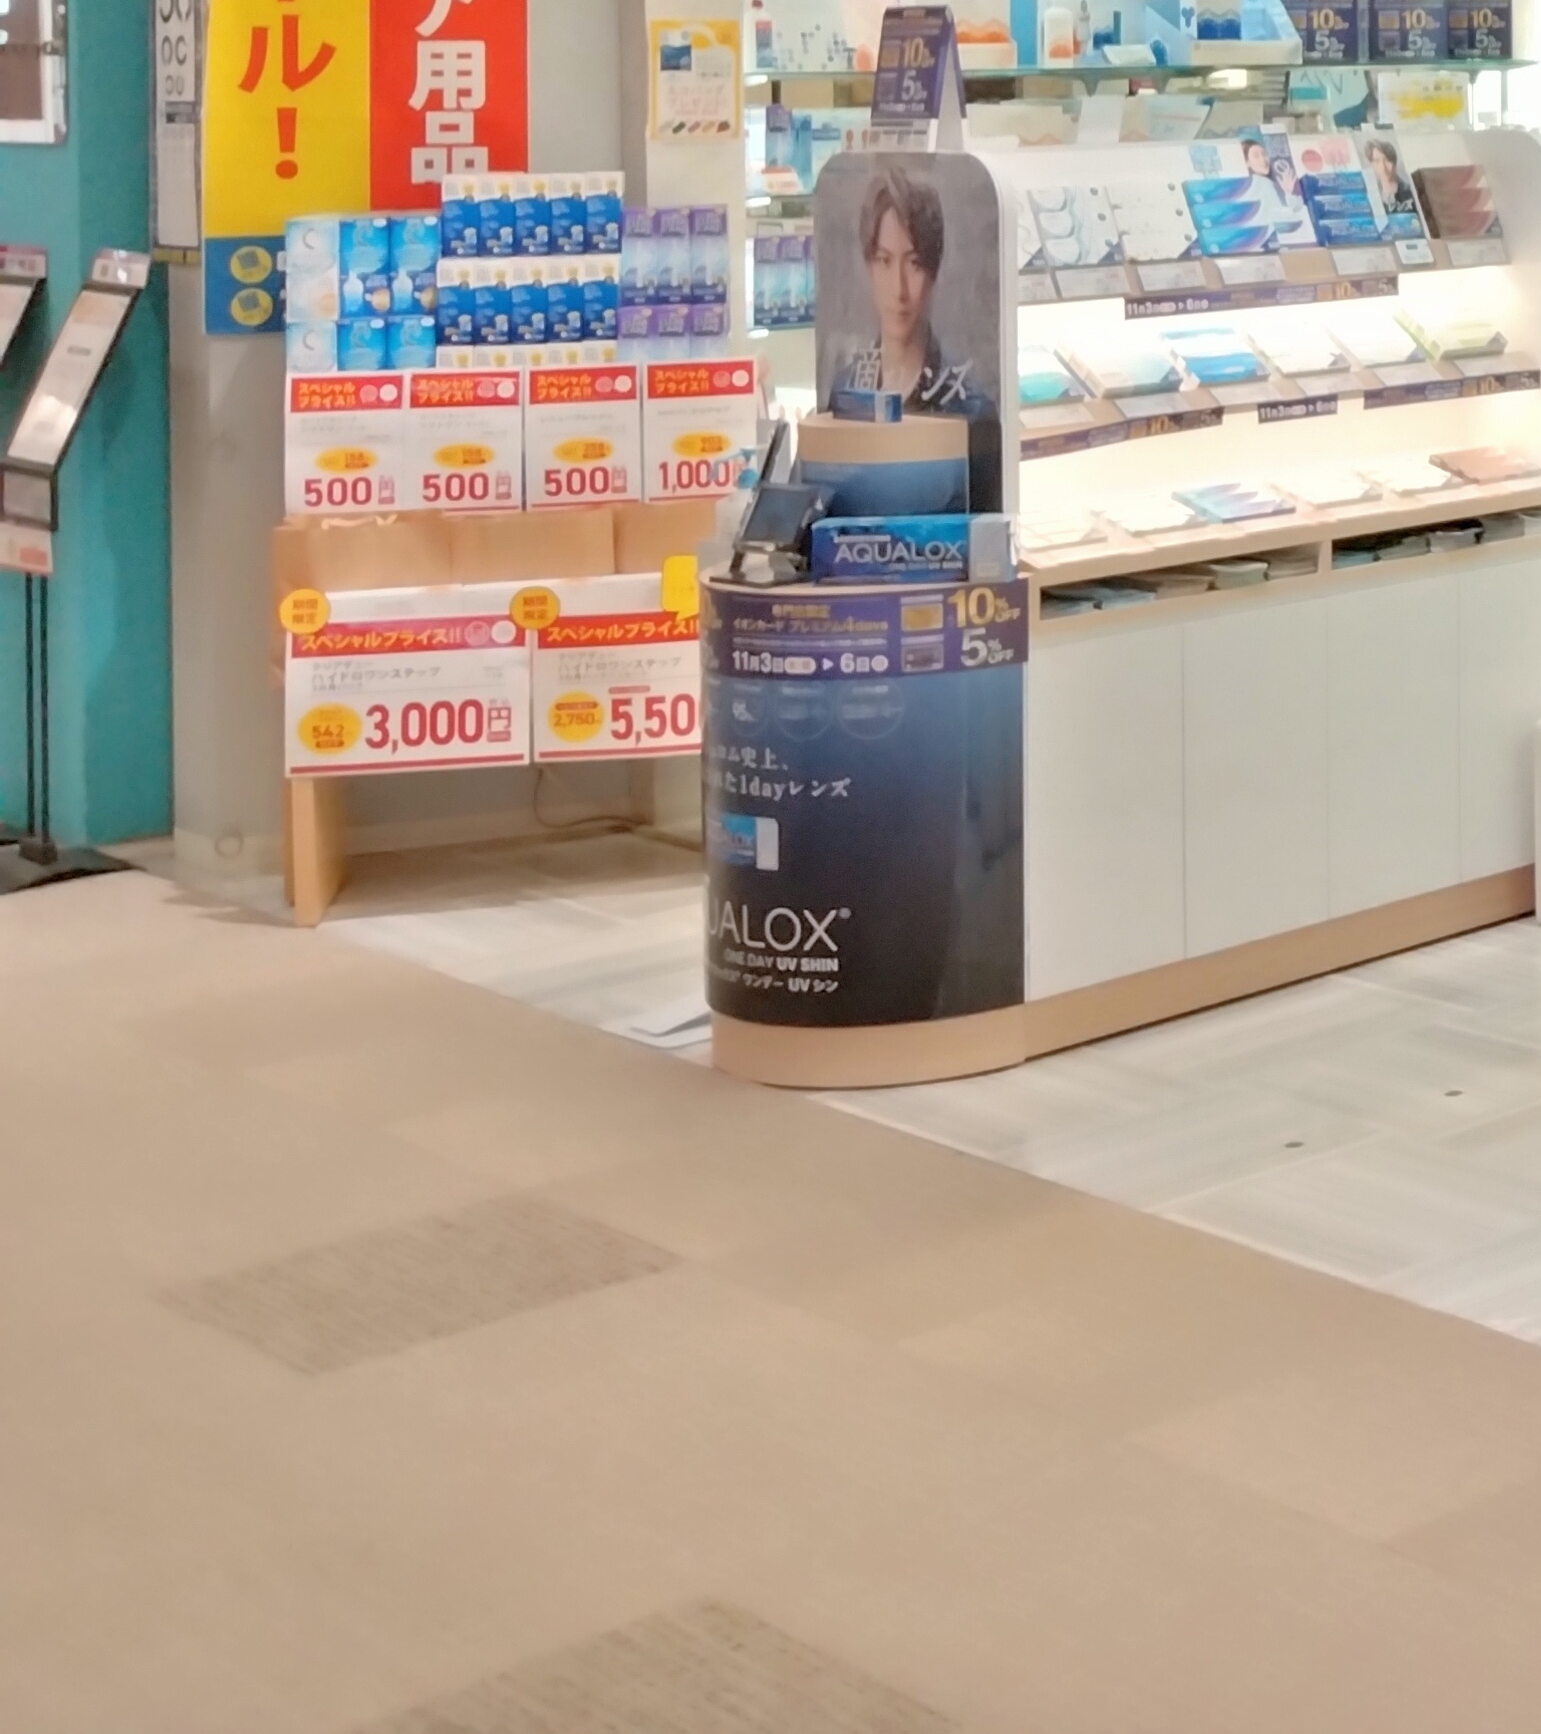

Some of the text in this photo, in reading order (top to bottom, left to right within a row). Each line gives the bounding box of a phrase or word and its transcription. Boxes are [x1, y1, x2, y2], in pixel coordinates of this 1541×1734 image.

[834, 541, 963, 564] AQUALOX
[311, 666, 441, 685] ハイドロワンステップ
[776, 956, 797, 973] UV
[800, 957, 839, 973] SHIN
[788, 977, 811, 993] UV
